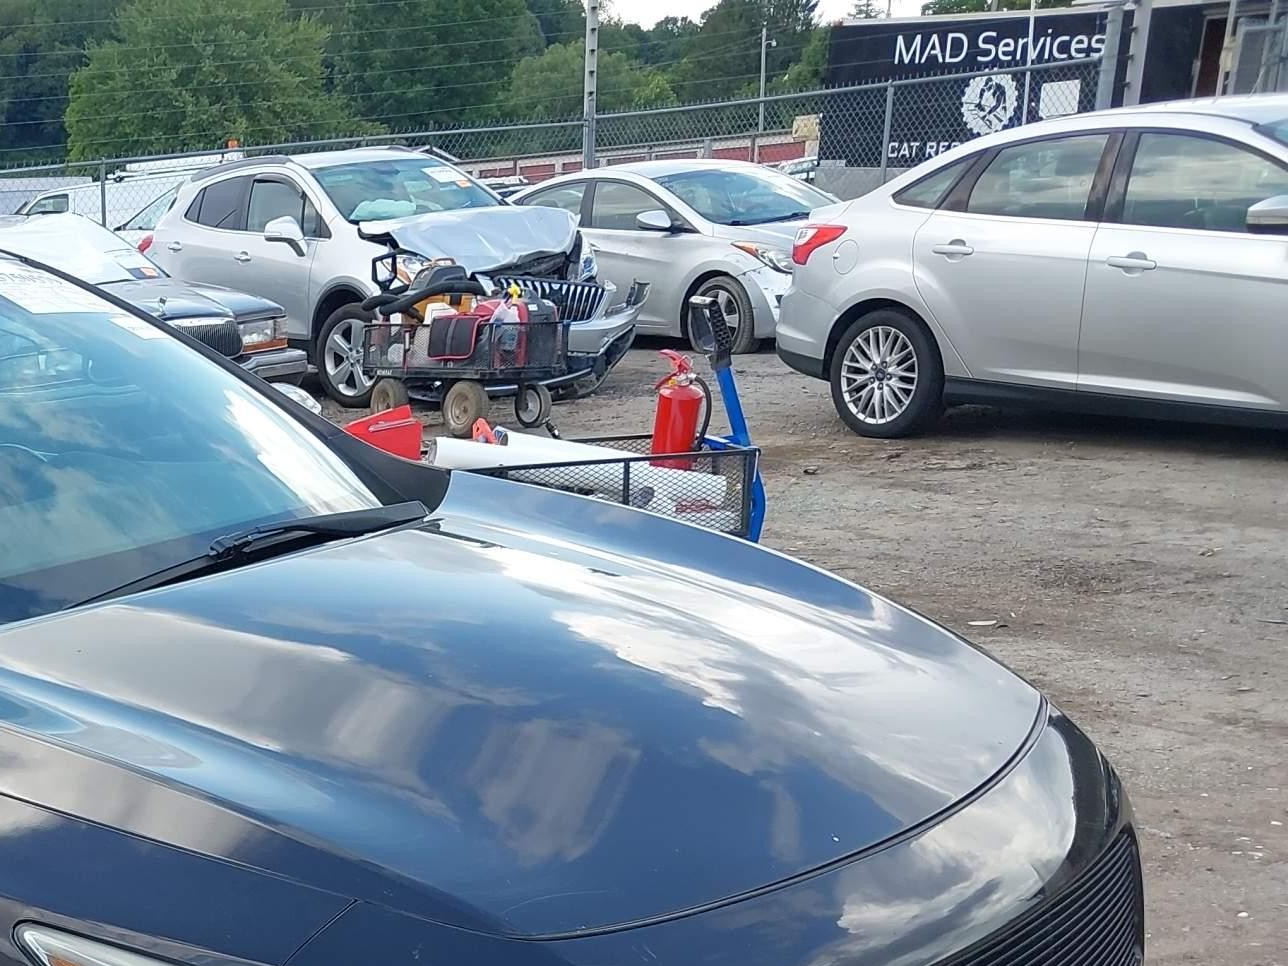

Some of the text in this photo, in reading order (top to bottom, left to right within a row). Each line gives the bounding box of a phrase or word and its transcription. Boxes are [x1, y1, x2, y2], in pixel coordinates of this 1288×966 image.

[894, 28, 1107, 65] MAD Services
[887, 141, 920, 158] CAT
